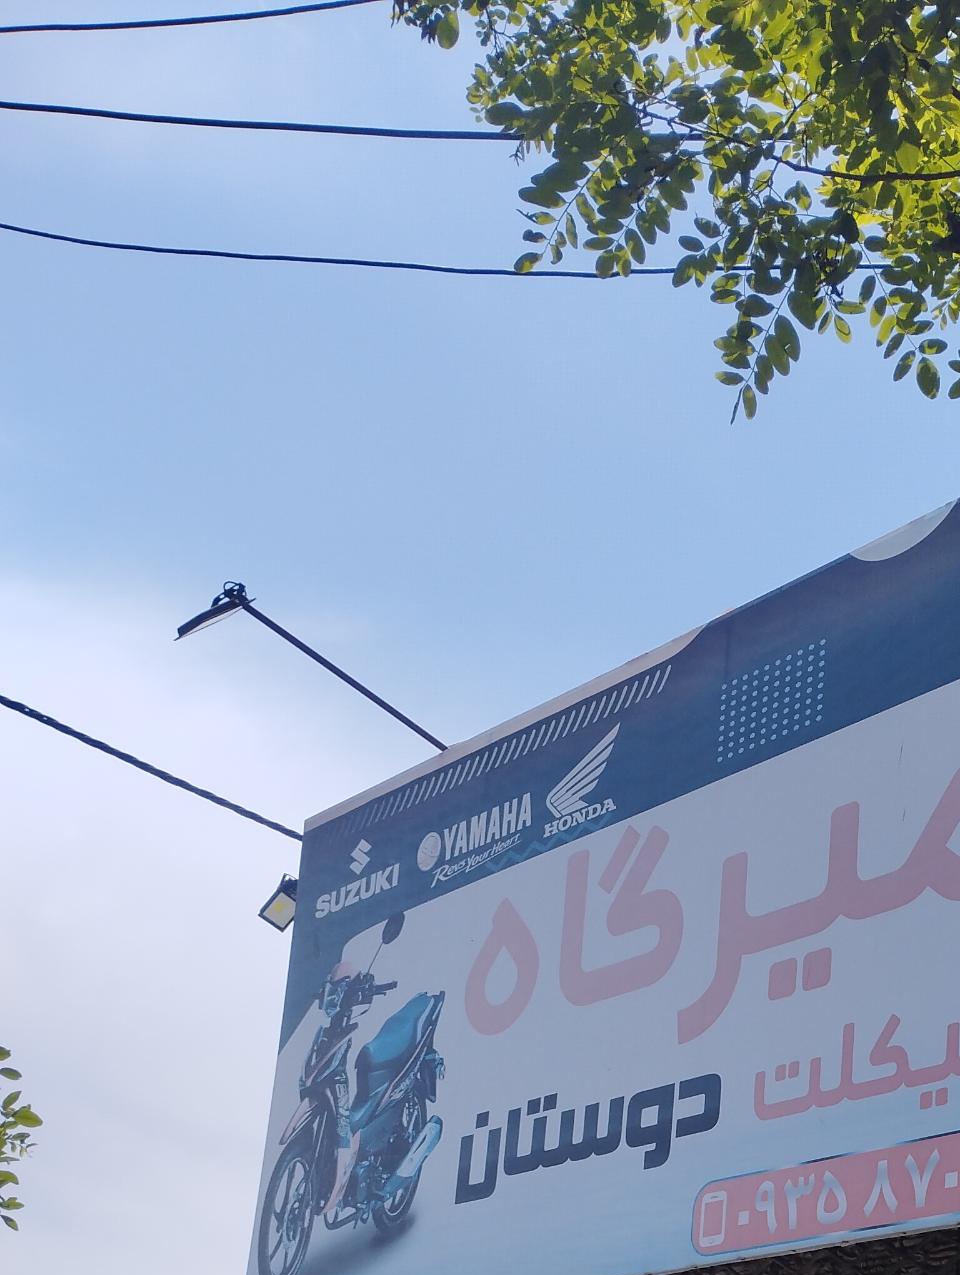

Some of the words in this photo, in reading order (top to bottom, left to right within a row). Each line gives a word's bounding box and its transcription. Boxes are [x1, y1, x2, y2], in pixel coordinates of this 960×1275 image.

[442, 792, 532, 861] YAMAHA
[543, 798, 616, 838] HONDA
[315, 863, 400, 918] SUZUKI
[454, 1073, 721, 1204] دوستان
